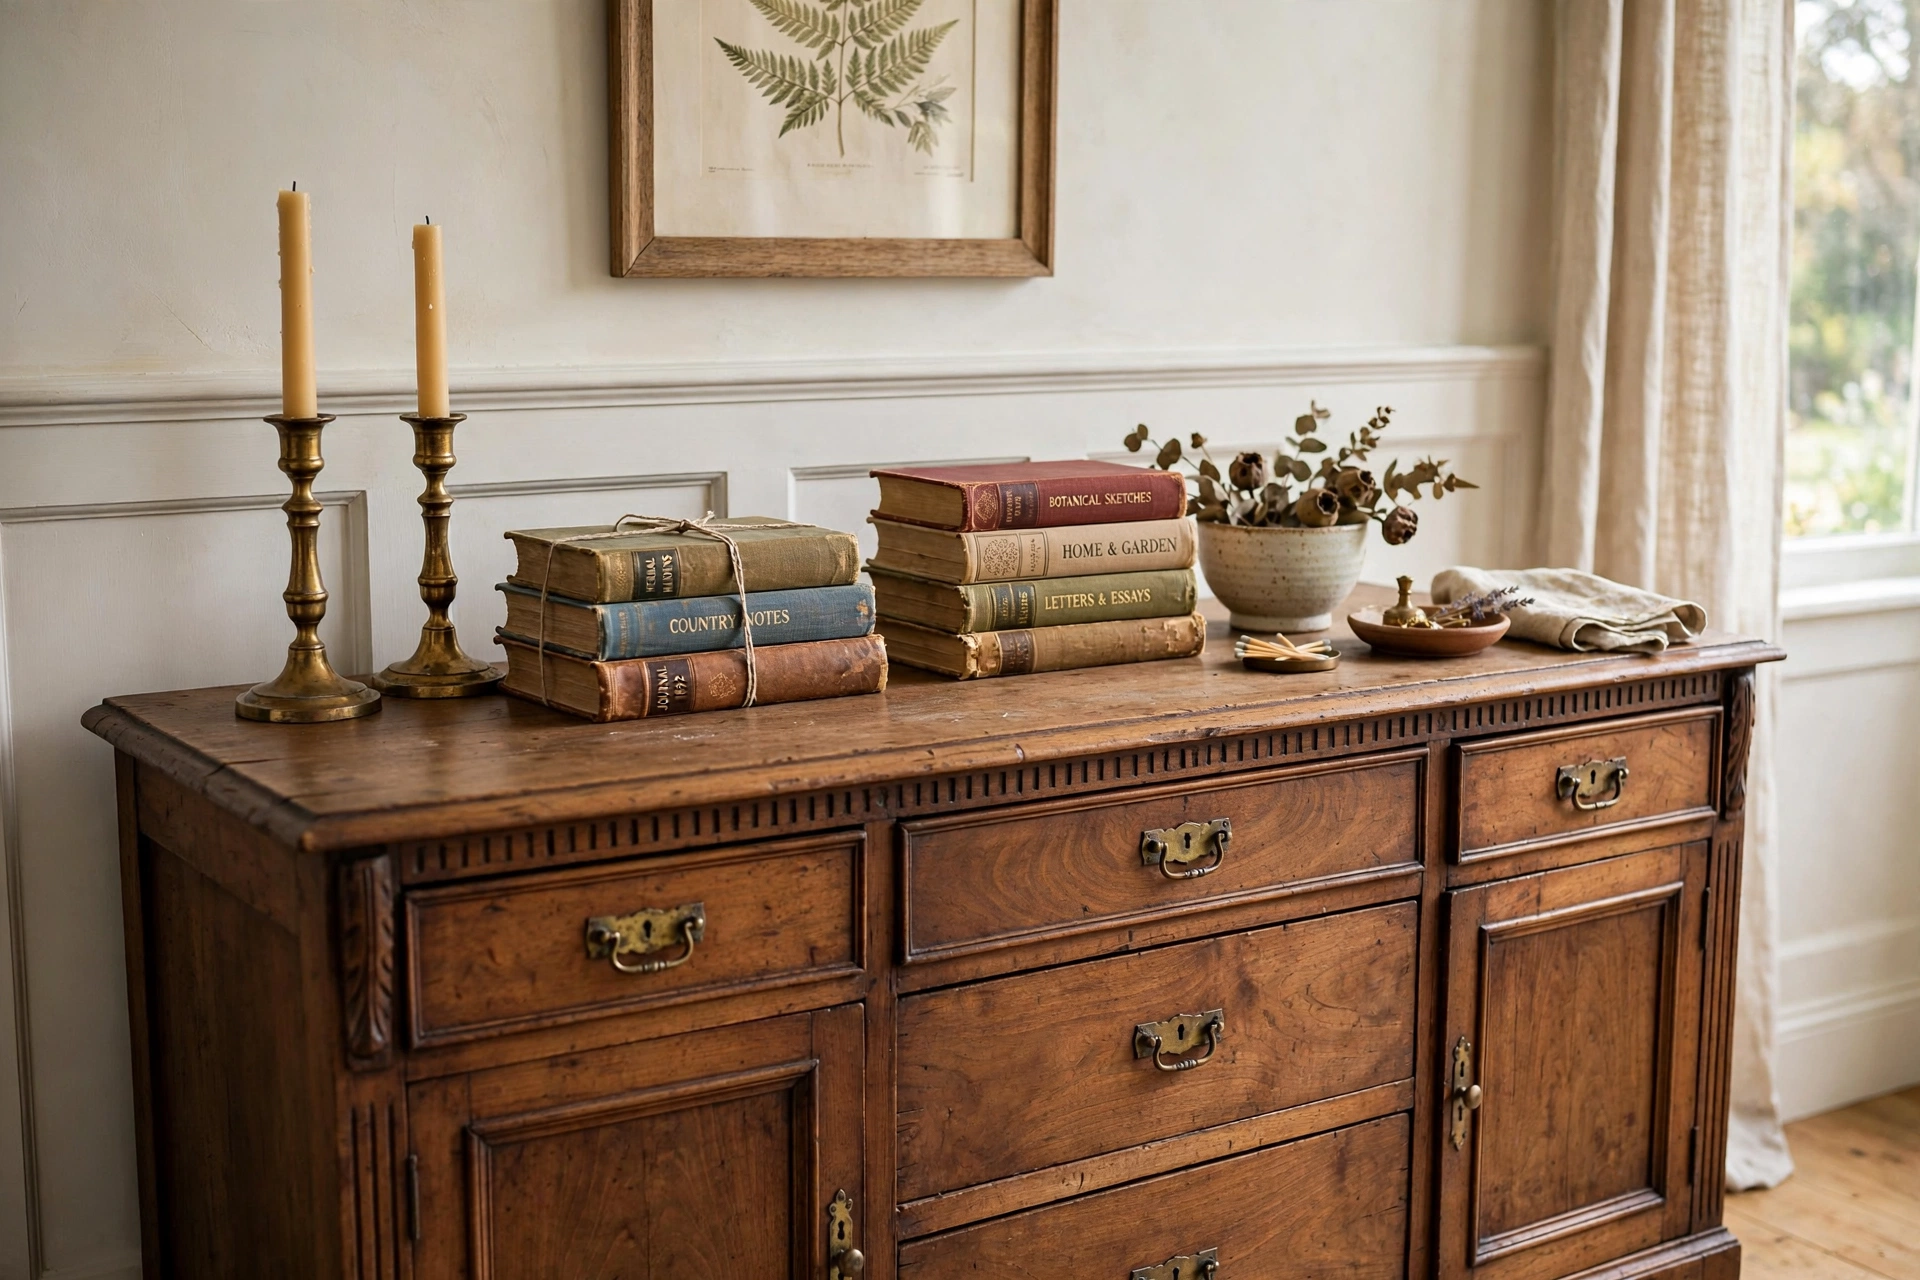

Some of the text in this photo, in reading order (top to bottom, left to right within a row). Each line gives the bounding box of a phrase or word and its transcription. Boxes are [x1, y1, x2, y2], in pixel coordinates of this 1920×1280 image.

[1049, 494, 1101, 508] BOTANICAL
[1104, 491, 1152, 505] SKETCHES
[1062, 537, 1177, 559] HOME & GARDEN
[1044, 593, 1095, 610] LETTERS
[1098, 592, 1107, 606] &
[1111, 588, 1151, 605] ESSAYS
[669, 614, 736, 634] COUNTRY
[656, 665, 669, 711] JOURNAL
